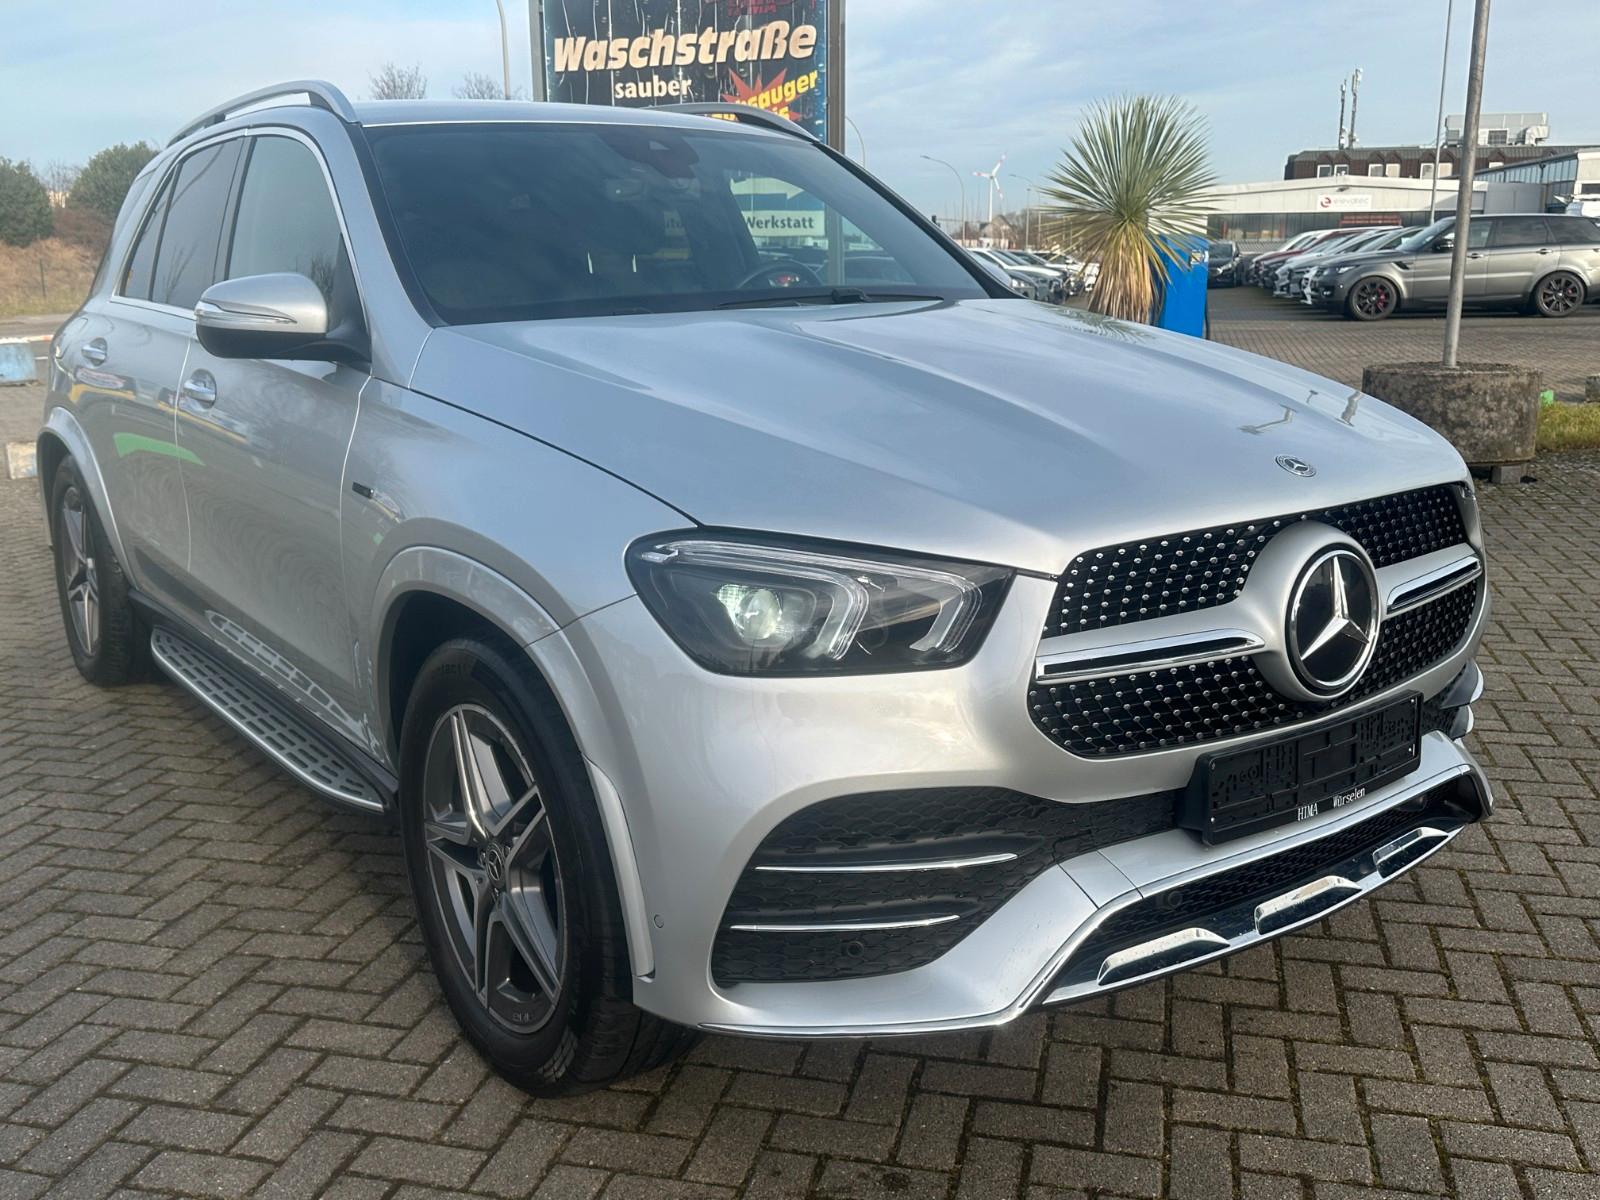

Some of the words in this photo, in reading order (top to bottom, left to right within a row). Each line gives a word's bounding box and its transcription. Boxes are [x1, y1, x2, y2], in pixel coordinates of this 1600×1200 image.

[554, 20, 817, 73] Waschstraße
[615, 75, 692, 99] sauber
[746, 215, 814, 229] Werkstatt
[1297, 803, 1318, 821] HIMA
